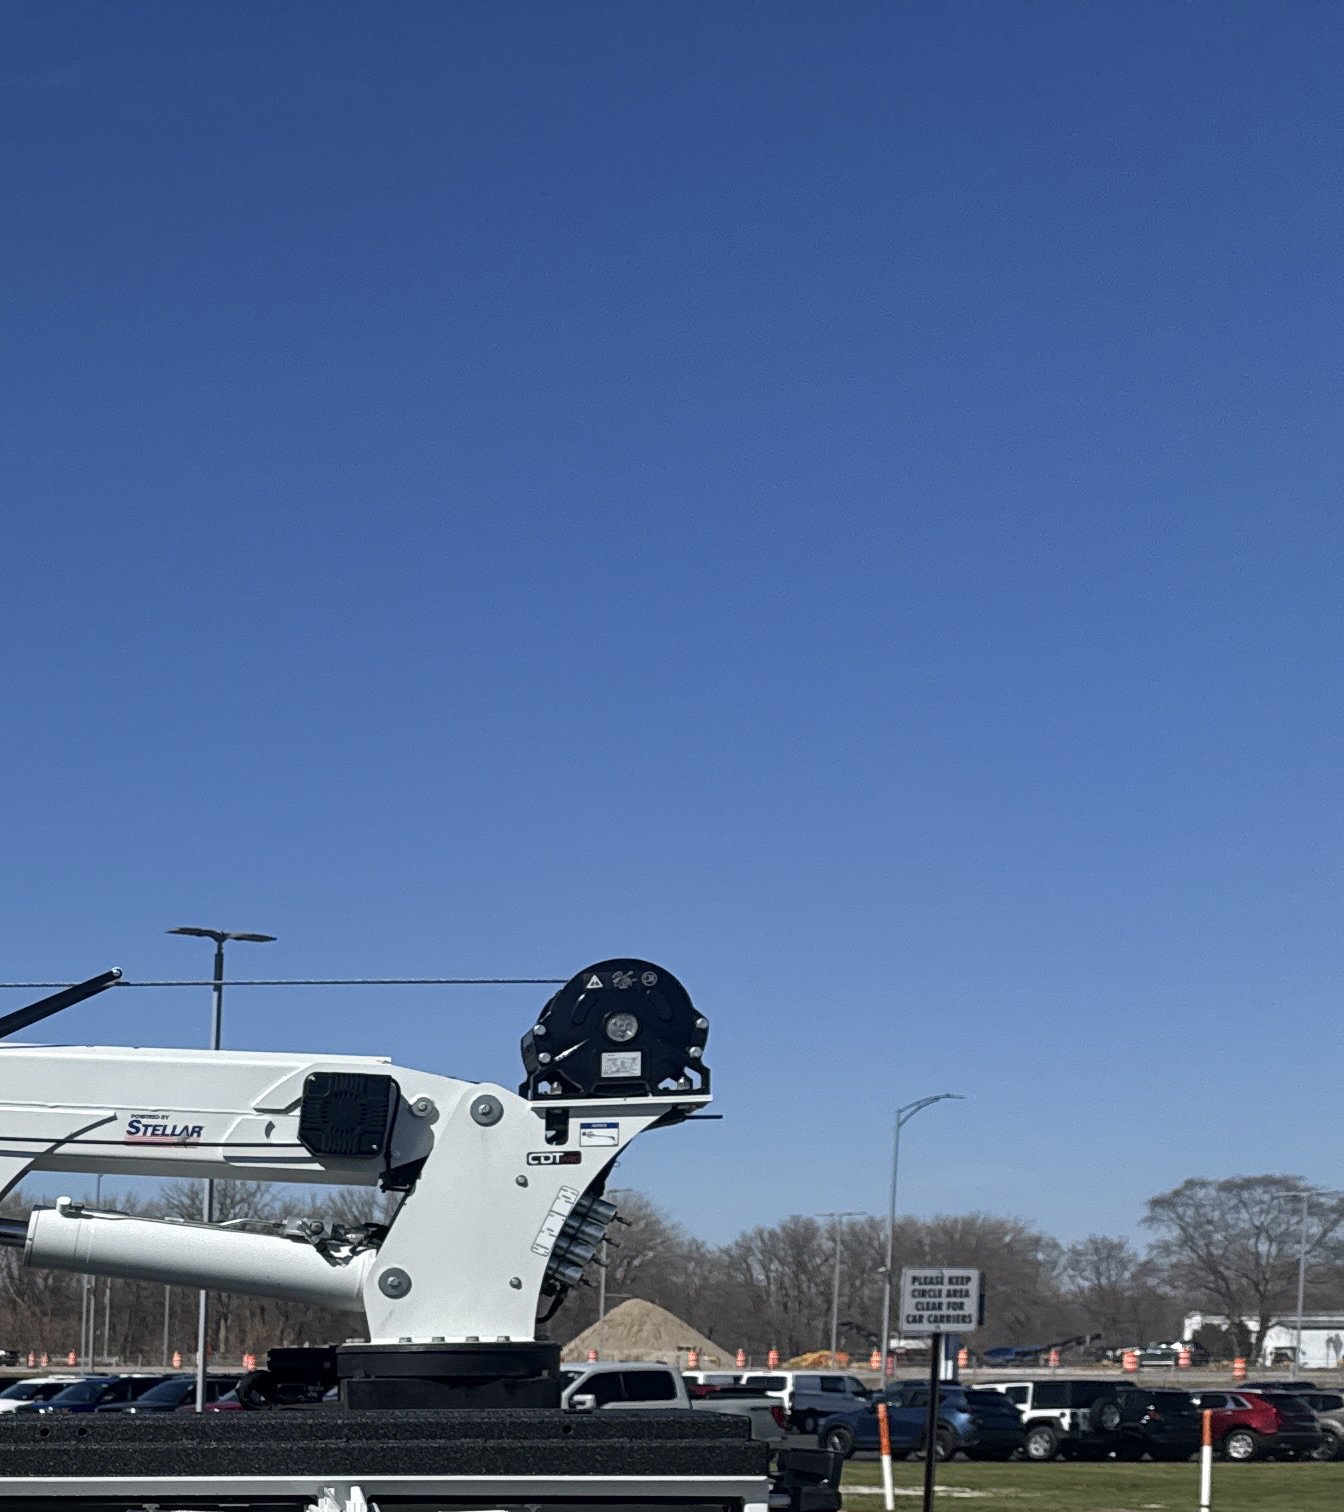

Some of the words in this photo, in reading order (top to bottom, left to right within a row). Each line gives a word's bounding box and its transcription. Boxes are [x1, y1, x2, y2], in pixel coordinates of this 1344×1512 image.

[126, 1119, 204, 1137] STELLAR
[528, 1152, 564, 1164] CDT
[911, 1275, 944, 1286] PLEASE
[948, 1276, 972, 1286] KEEP
[911, 1288, 943, 1298] CIRCLE
[946, 1288, 970, 1298] AREA
[915, 1301, 943, 1311] CLEAR
[946, 1301, 965, 1311] FOR
[905, 1313, 924, 1324] CAR
[927, 1313, 973, 1324] CARRIERS
